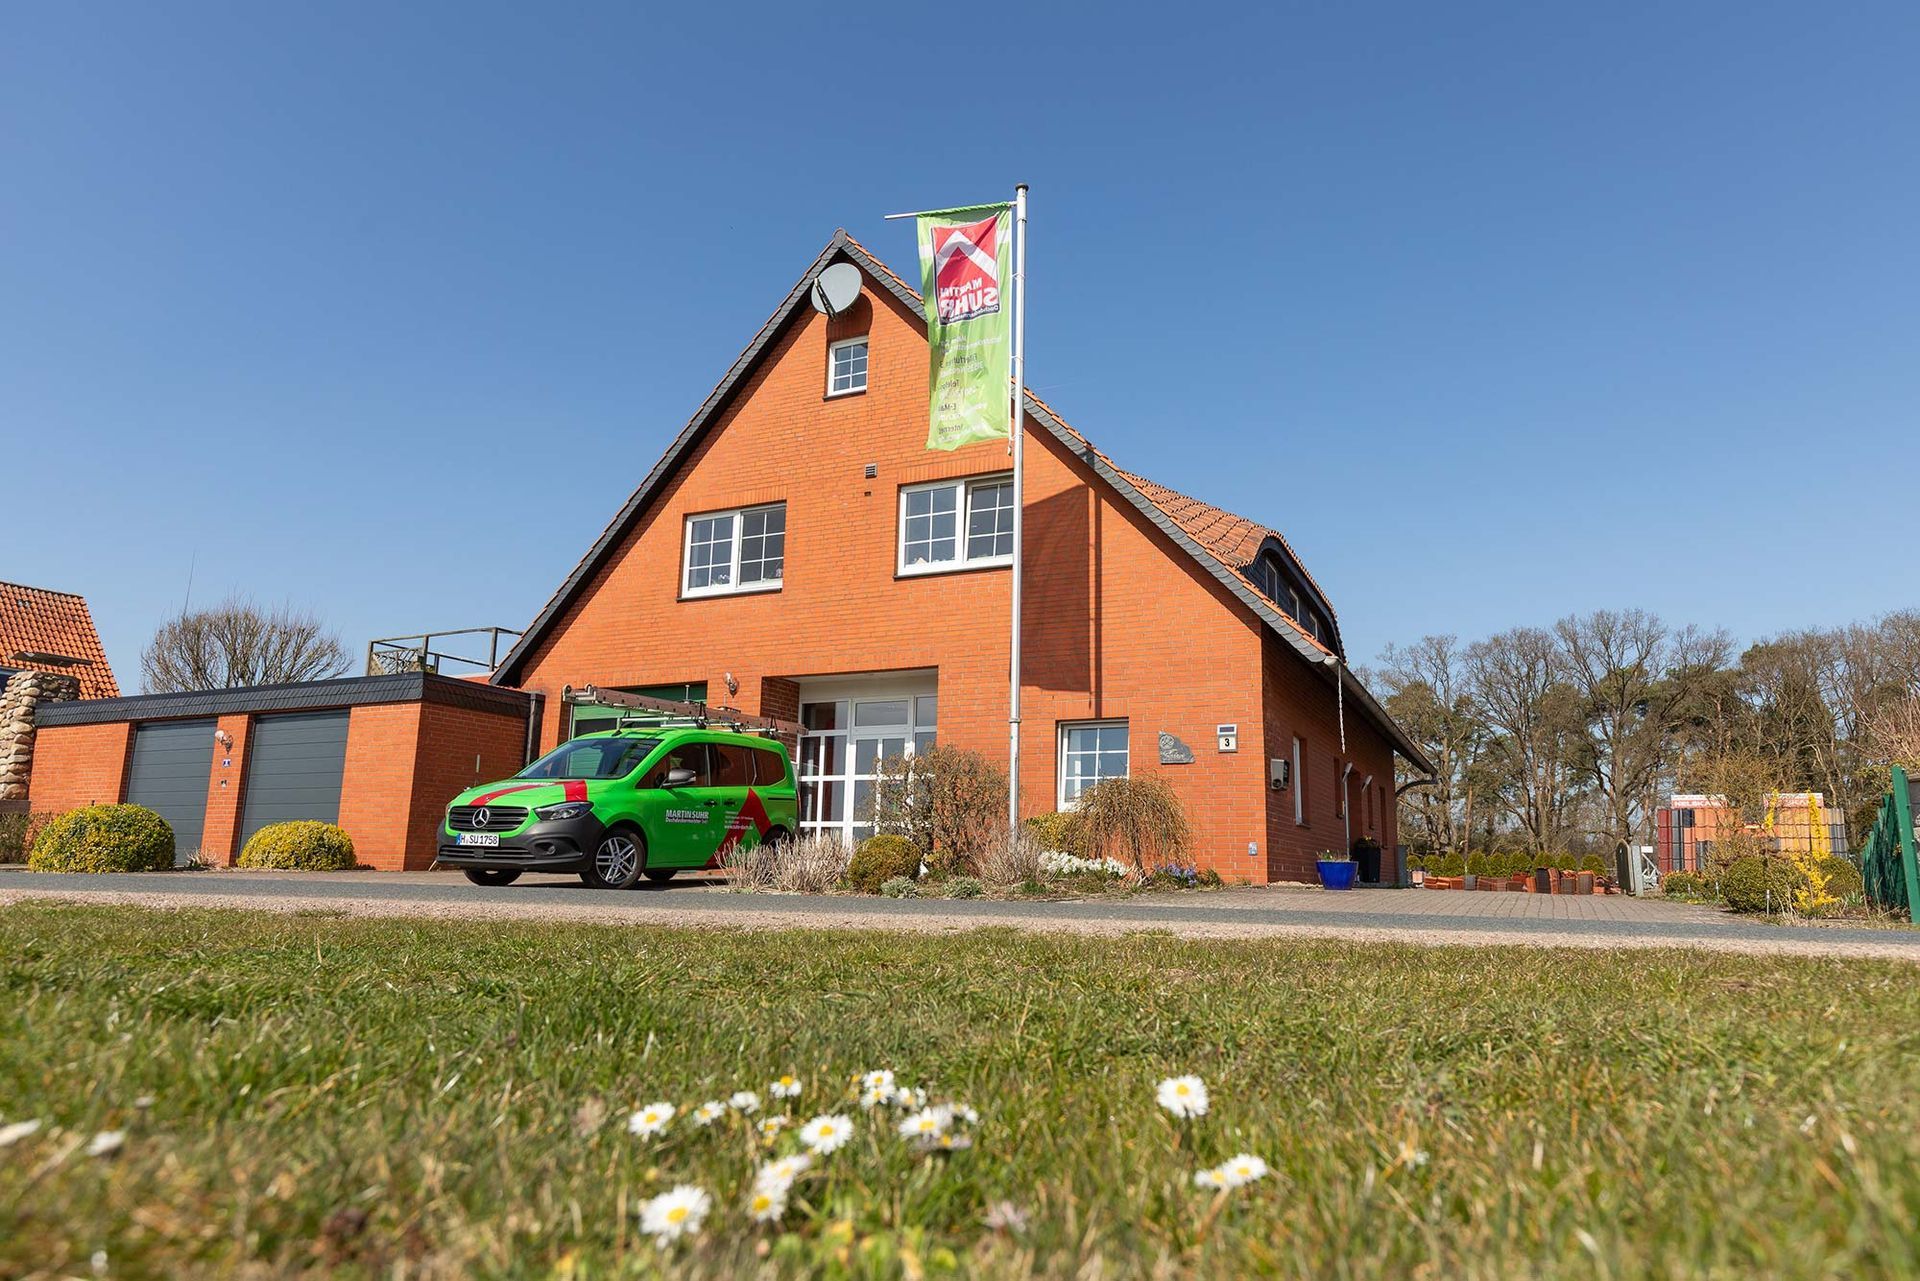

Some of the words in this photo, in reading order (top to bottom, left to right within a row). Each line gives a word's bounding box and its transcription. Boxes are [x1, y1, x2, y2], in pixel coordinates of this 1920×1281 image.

[1224, 738, 1230, 747] 3
[665, 809, 692, 819] MARTIN
[692, 811, 709, 819] SUHR
[469, 835, 479, 844] SU
[480, 836, 498, 845] 1758
